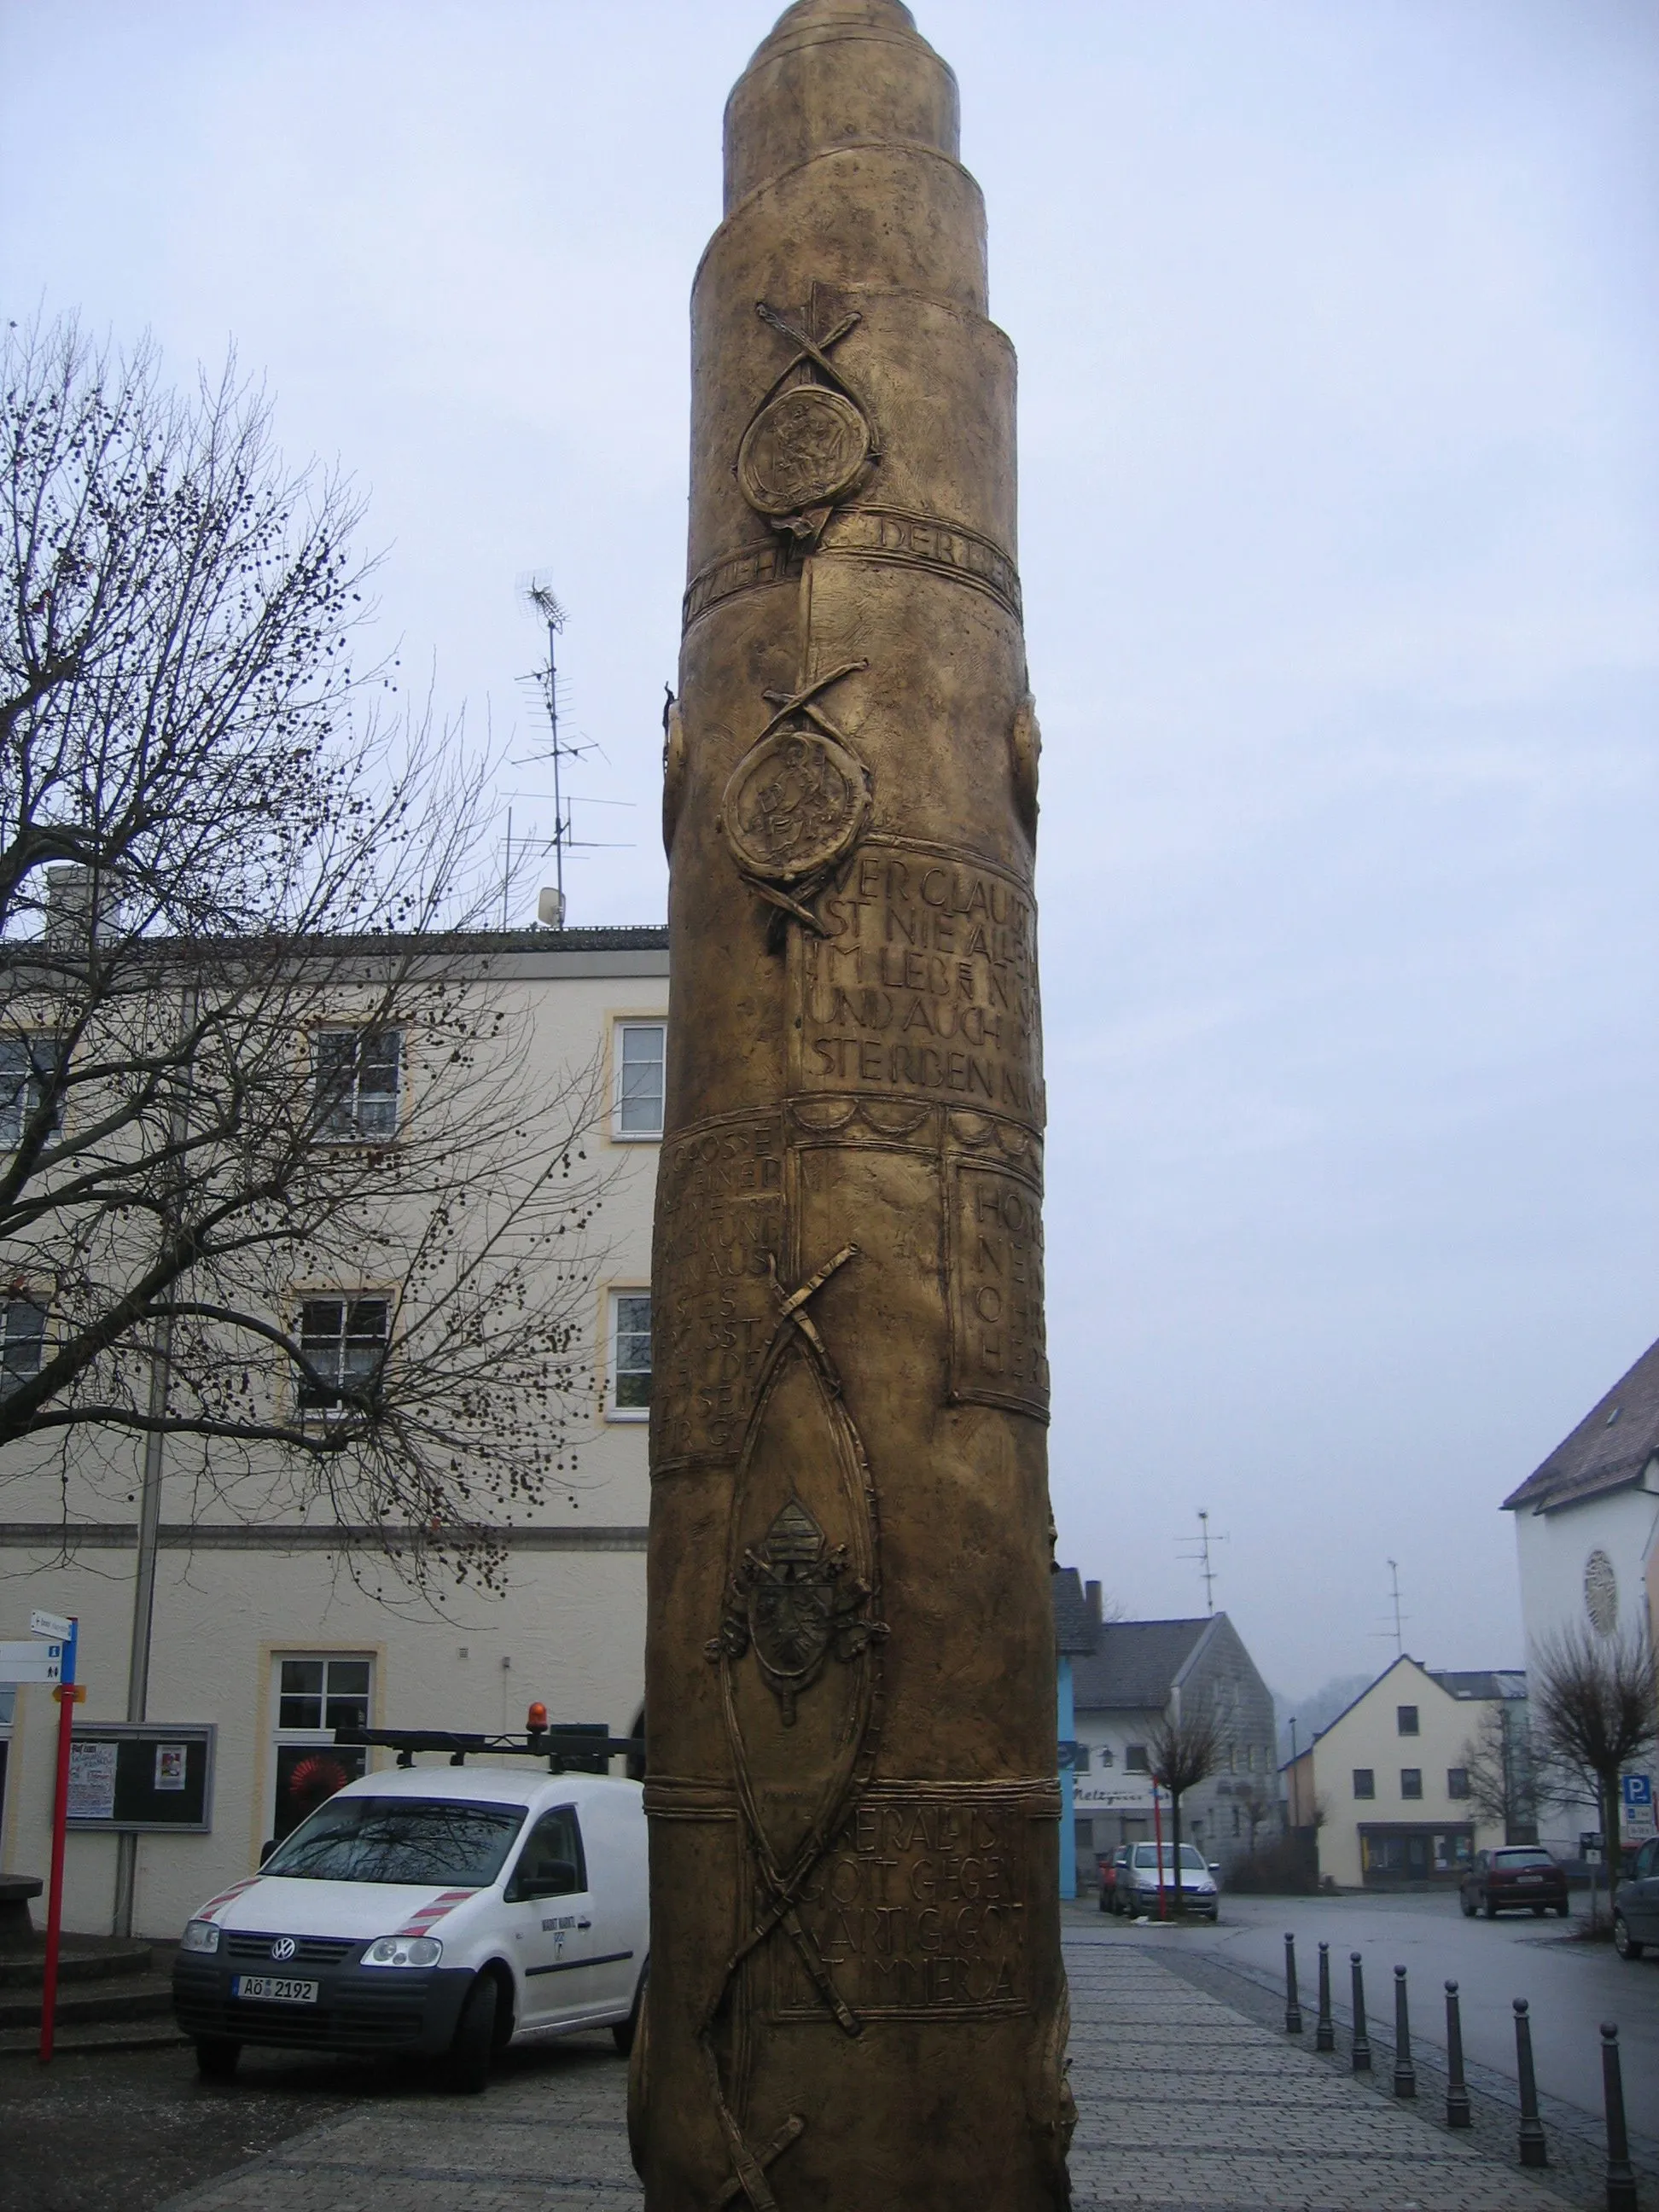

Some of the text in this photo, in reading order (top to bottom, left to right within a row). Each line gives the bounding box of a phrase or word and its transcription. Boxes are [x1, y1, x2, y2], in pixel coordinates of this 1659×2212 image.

[879, 519, 956, 563] DER
[809, 1035, 994, 1099] STERBEN
[1629, 1778, 1644, 1801] P
[244, 1978, 311, 2000] AÖ 2192
